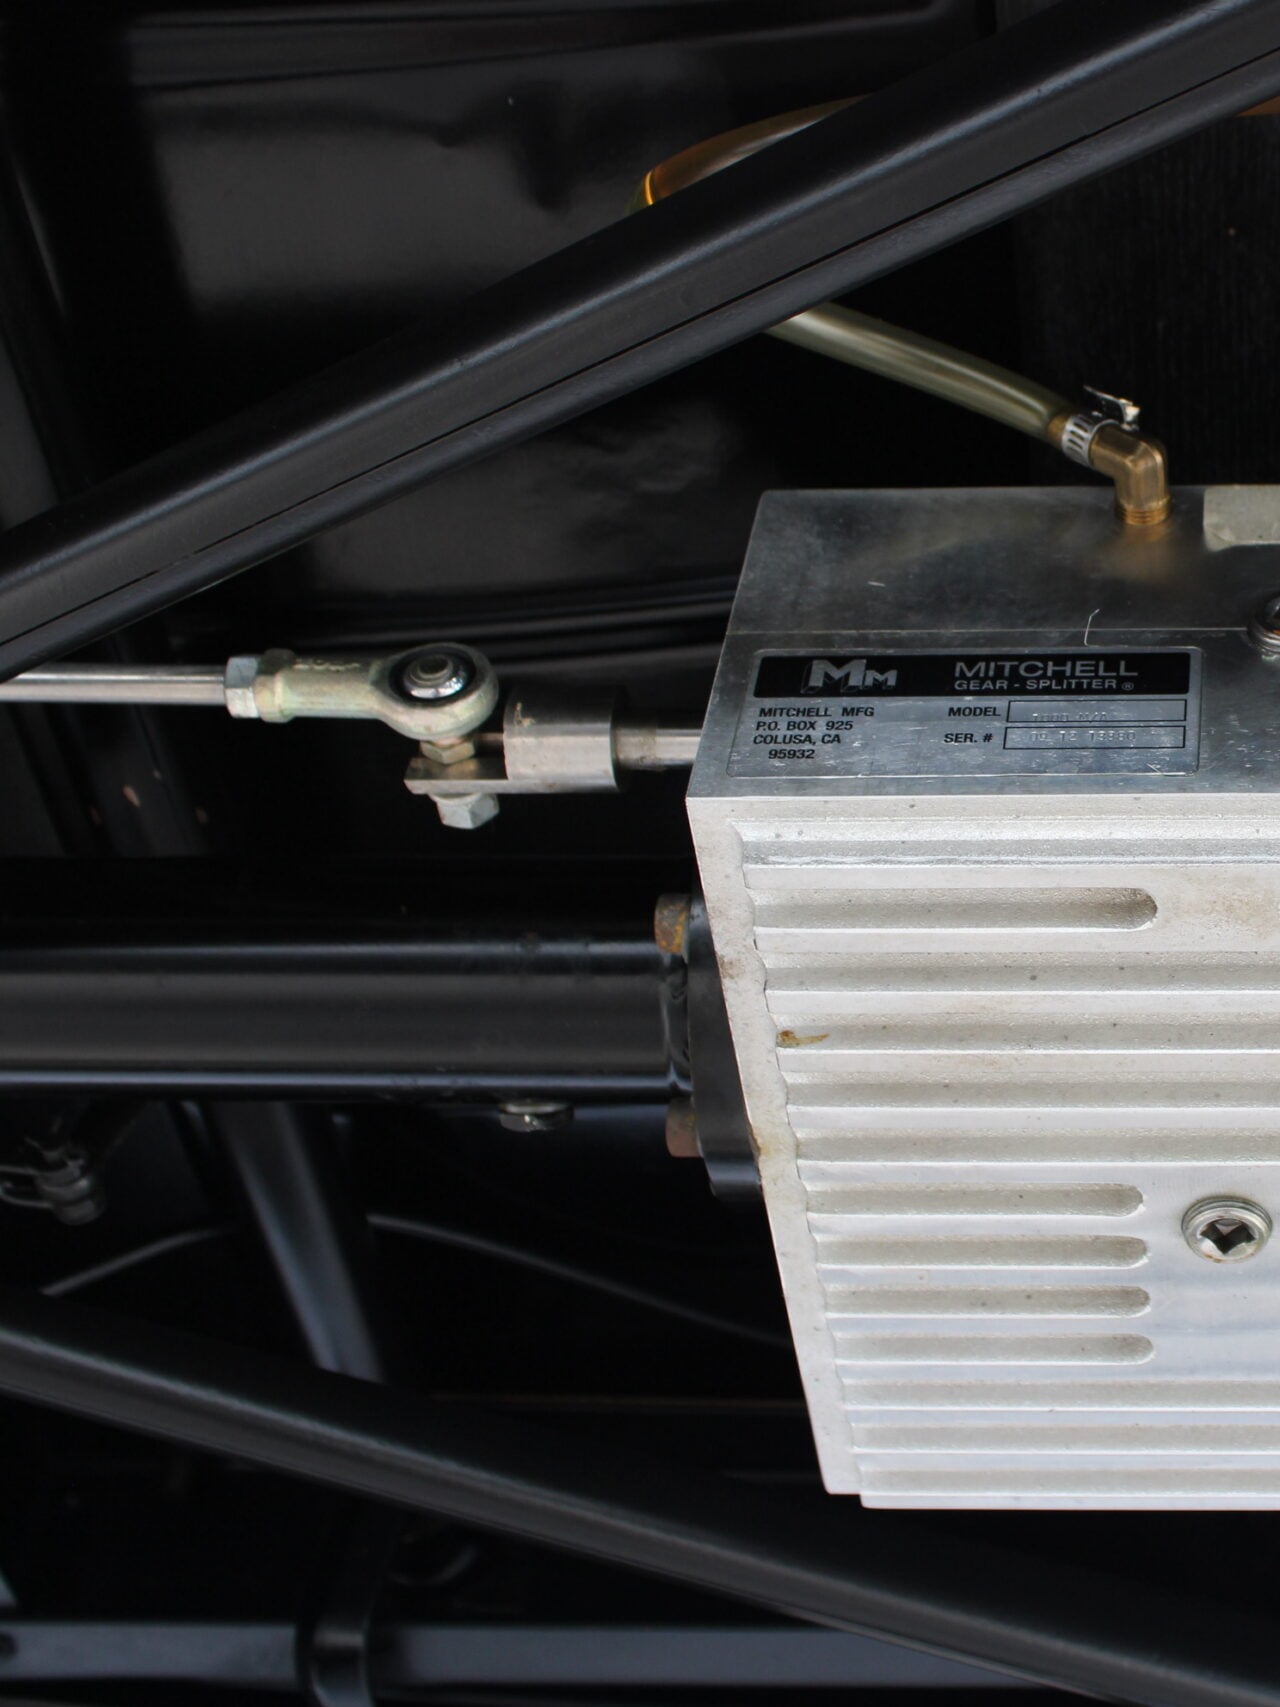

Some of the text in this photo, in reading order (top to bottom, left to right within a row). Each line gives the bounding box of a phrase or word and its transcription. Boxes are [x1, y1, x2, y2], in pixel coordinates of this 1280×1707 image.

[955, 660, 1138, 677] MITCHELL
[954, 680, 1008, 690] GEAR
[758, 707, 875, 717] MITCHELL MFG
[948, 706, 1001, 717] MODEL
[756, 720, 854, 731] P.O. BOX 925
[753, 734, 842, 745] COLUSA, CA
[944, 733, 977, 743] SER.
[983, 733, 993, 742] #
[768, 749, 815, 759] 95932
